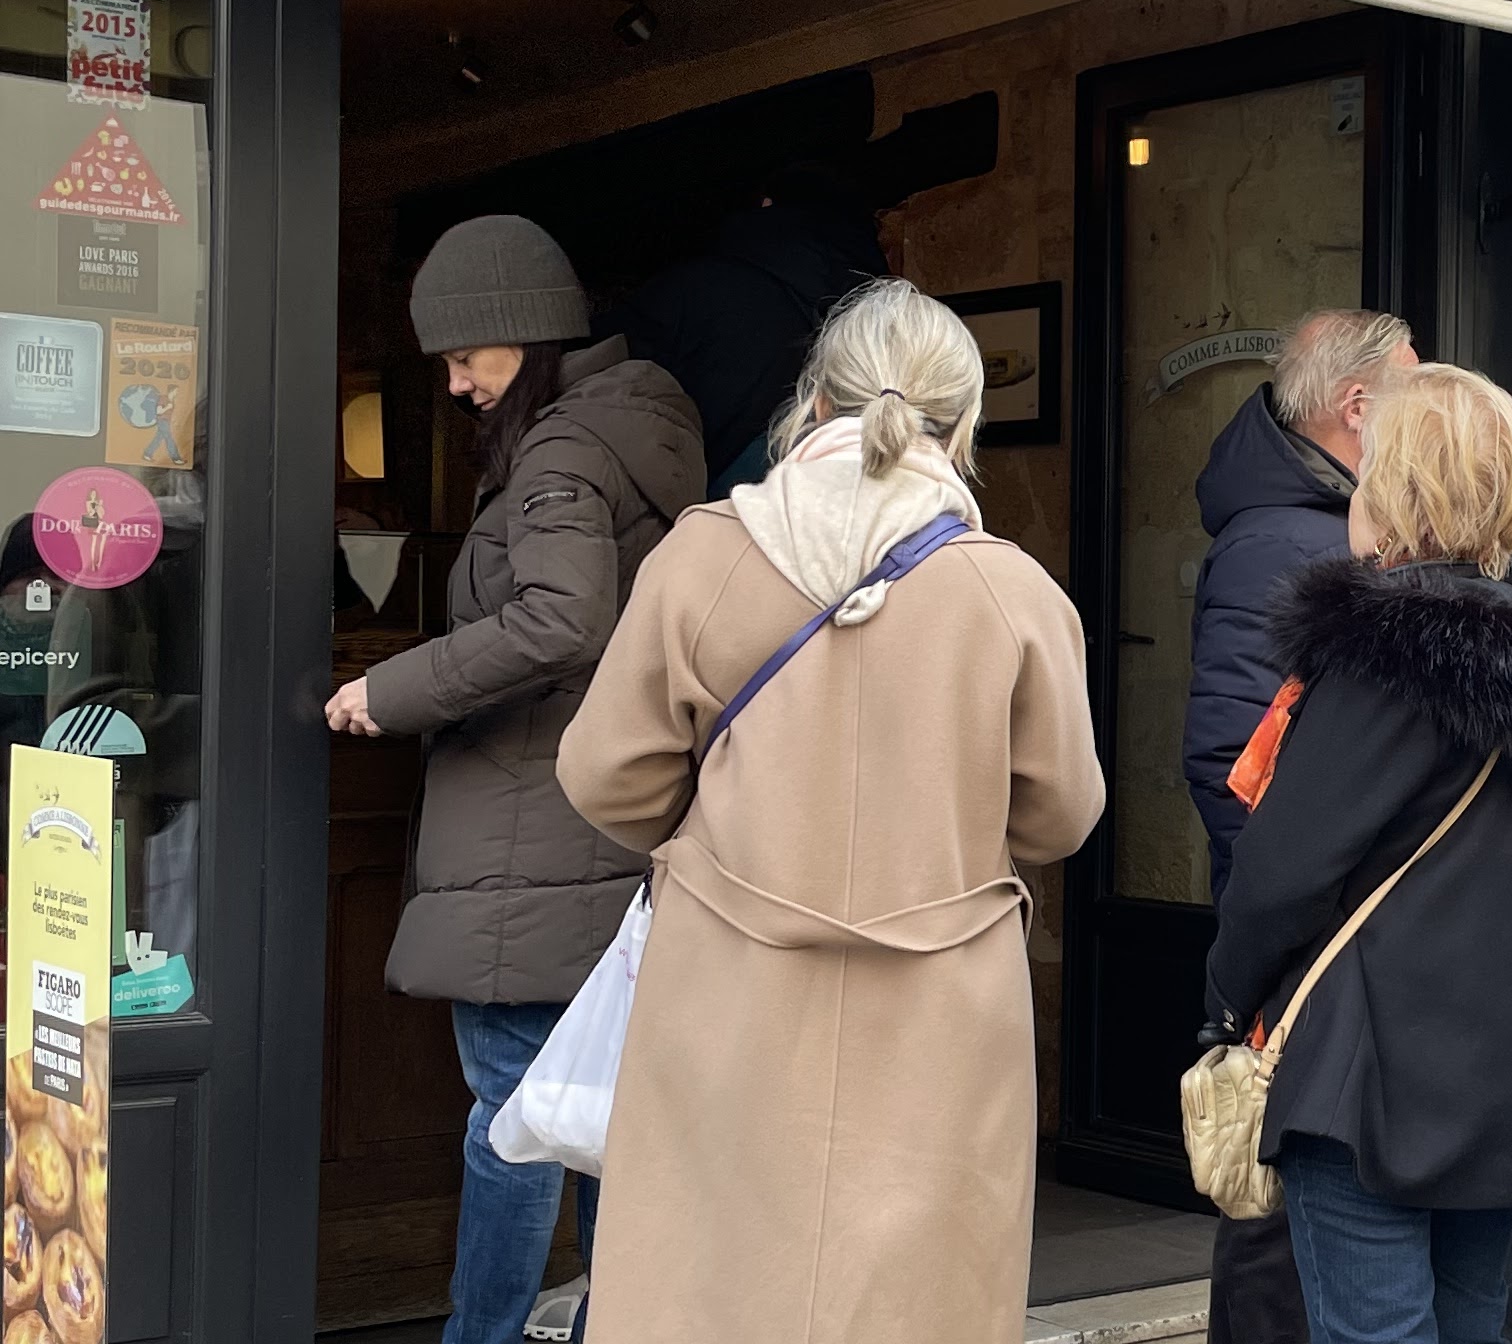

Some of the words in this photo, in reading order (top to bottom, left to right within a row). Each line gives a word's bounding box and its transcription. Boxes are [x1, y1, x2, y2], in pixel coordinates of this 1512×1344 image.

[82, 11, 136, 37] 2015
[72, 59, 144, 82] petit
[39, 198, 181, 223] guidedesgourmands.fr
[79, 246, 105, 261] LOVE
[109, 248, 138, 264] PARIS
[79, 262, 114, 275] AWARDS
[116, 265, 139, 278] 2016
[79, 274, 138, 295] GAGNANT
[134, 341, 193, 353] Routard
[1168, 342, 1220, 375] COMME
[1223, 340, 1232, 354] A
[17, 344, 73, 376] COFFEE
[0, 647, 80, 669] epicery
[33, 897, 45, 914] des
[35, 881, 42, 896] Le
[44, 883, 58, 902] plus
[60, 889, 87, 909] parisien
[38, 969, 81, 998] FIGARO
[114, 984, 180, 1001] deliveroo
[45, 991, 73, 1016] SCOPE
